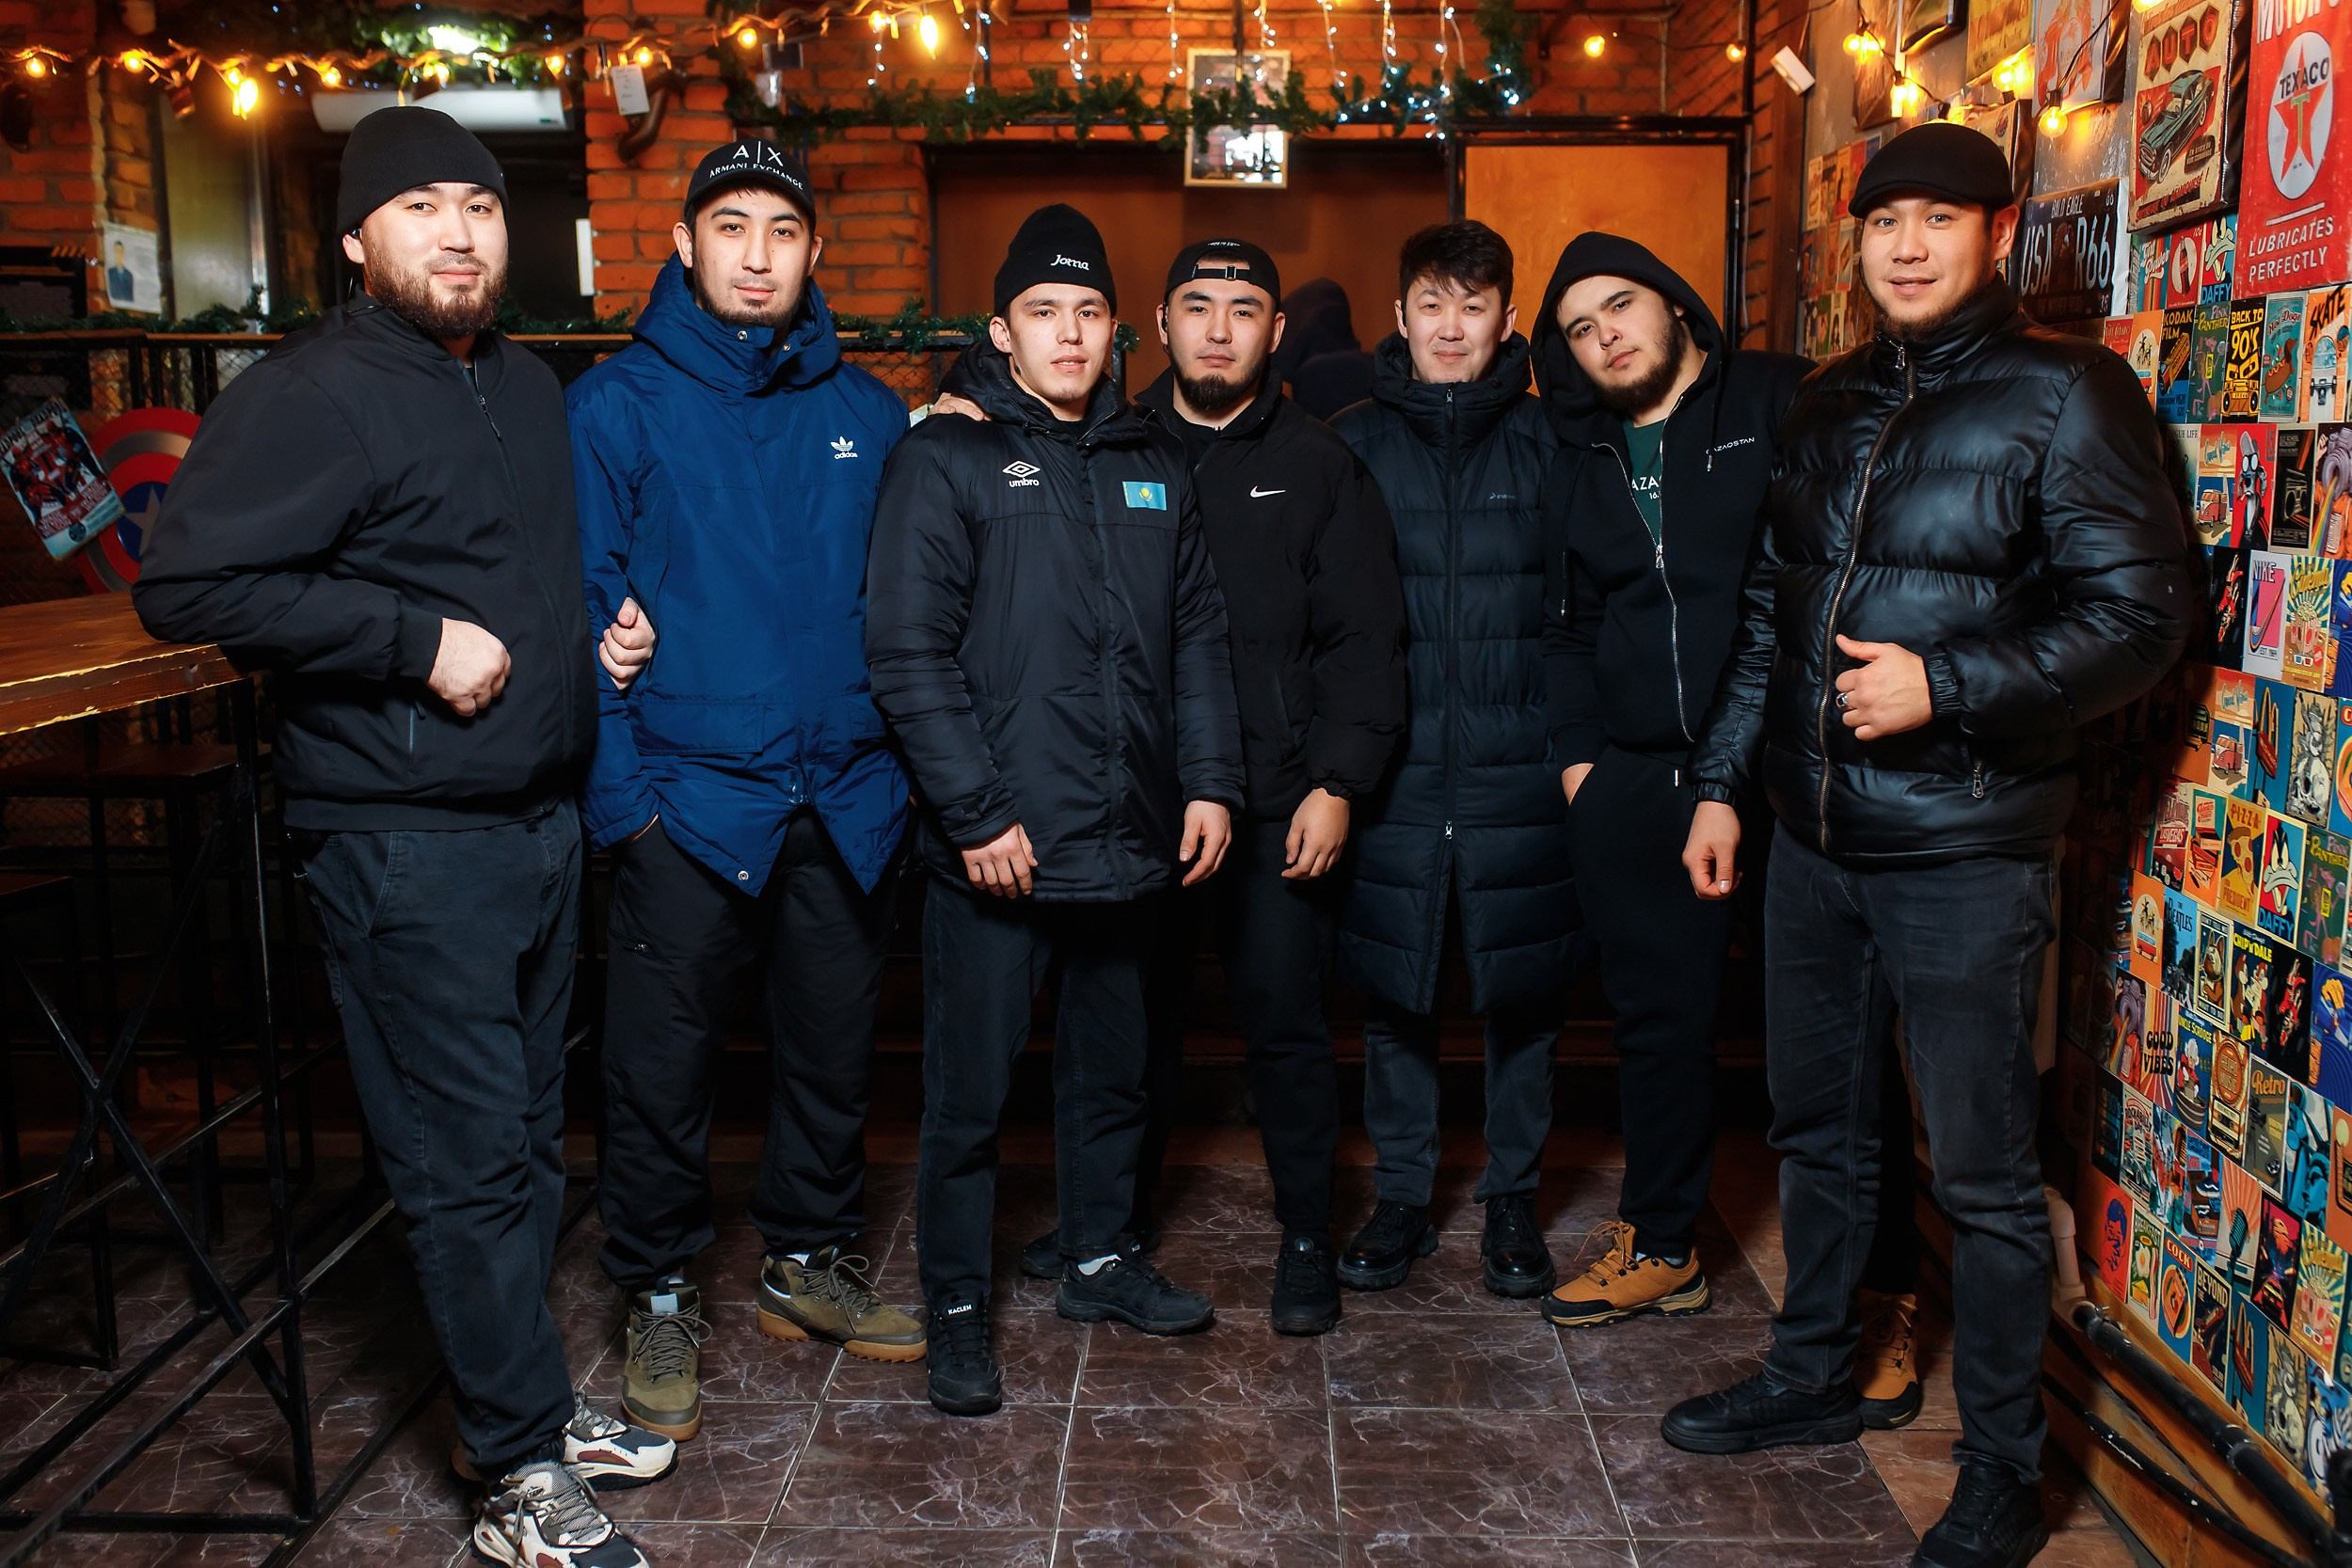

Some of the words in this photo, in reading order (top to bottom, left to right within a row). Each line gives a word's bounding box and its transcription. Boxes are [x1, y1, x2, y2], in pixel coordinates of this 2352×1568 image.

[2145, 13, 2216, 68] AUTO
[2280, 56, 2330, 99] TEXACO
[2290, 92, 2311, 148] T
[709, 163, 748, 179] ARMANI
[753, 163, 804, 190] EXCHANGE
[2066, 194, 2085, 215] EAGLE
[2249, 215, 2335, 258] LUBRICATES
[1051, 254, 1089, 271] Joma
[2021, 223, 2052, 296] USA
[2074, 213, 2110, 291] R66
[2249, 245, 2328, 283] PERFECTLY
[2201, 283, 2233, 304] DAFFY
[2163, 309, 2193, 327] KODAK
[2231, 309, 2251, 325] BACK
[2253, 308, 2265, 323] TO
[2281, 309, 2302, 324] Dogs
[2310, 285, 2346, 341] SKATE
[2162, 326, 2180, 341] FILM
[2186, 429, 2198, 438] LIFE
[834, 451, 858, 460] adidas
[1009, 477, 1040, 487] umbro
[2251, 560, 2276, 584] NIKE
[2167, 829, 2184, 844] VEGAS
[2167, 896, 2193, 933] BEATLES
[2258, 910, 2296, 943] DAFFY
[2233, 932, 2250, 950] CHIP
[2147, 1030, 2174, 1051] GOOD
[2144, 1053, 2174, 1077] VIBES
[2251, 1069, 2286, 1096] Retro
[2197, 1265, 2230, 1309] BEYOND
